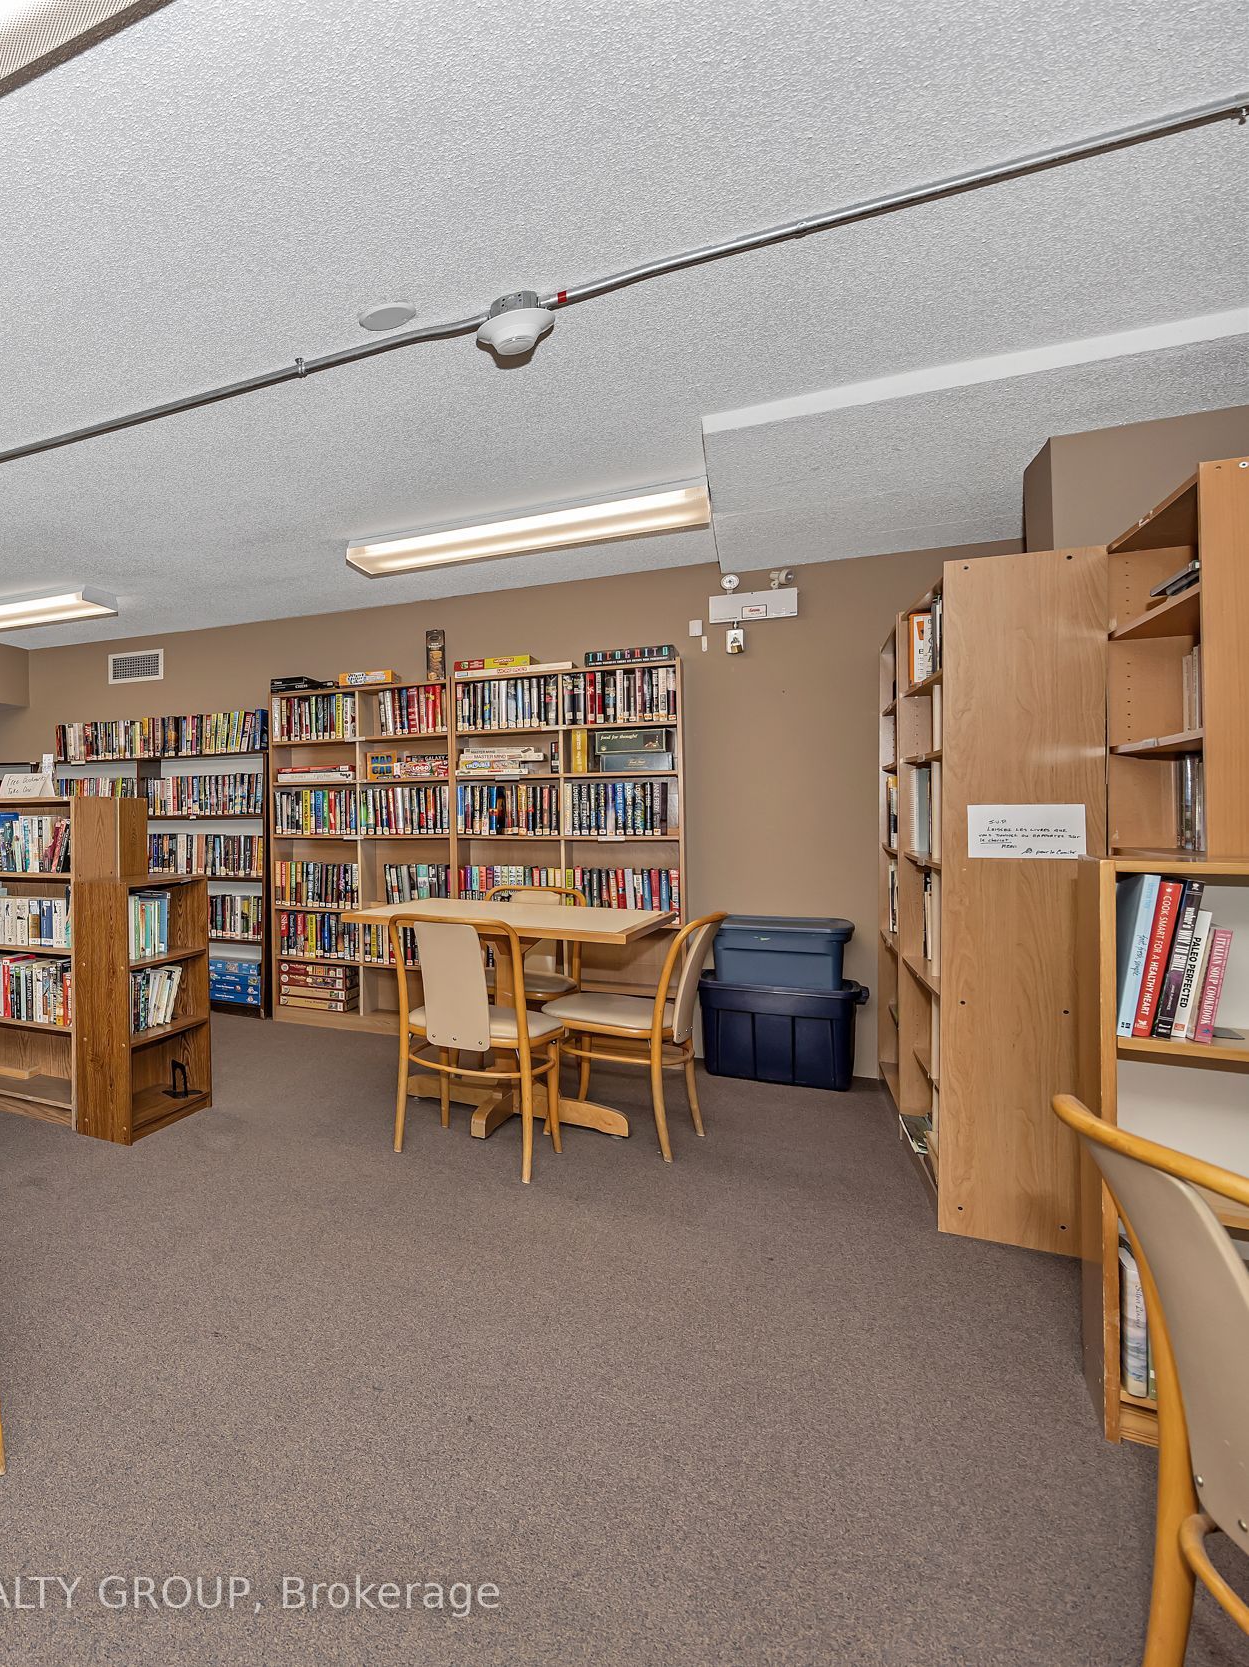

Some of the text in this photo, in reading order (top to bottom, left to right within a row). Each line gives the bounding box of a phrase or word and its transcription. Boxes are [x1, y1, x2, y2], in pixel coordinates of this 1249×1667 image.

[588, 646, 668, 662] INCOGNITO
[371, 756, 392, 764] MAD
[372, 765, 392, 775] GAB
[1161, 895, 1172, 915] COOK
[1155, 916, 1167, 939] SMART
[1176, 929, 1190, 945] WAY
[1153, 940, 1162, 953] FOR
[1174, 945, 1187, 954] TO
[1214, 936, 1227, 964] ITALIAN
[1170, 954, 1185, 971] GRILL
[1144, 961, 1159, 994] HEALTHY
[1179, 937, 1201, 1008] PALEO PERFECTED
[1209, 965, 1223, 984] SOUP
[1141, 995, 1153, 1015] HEART
[1200, 985, 1218, 1024] COOKBOOK
